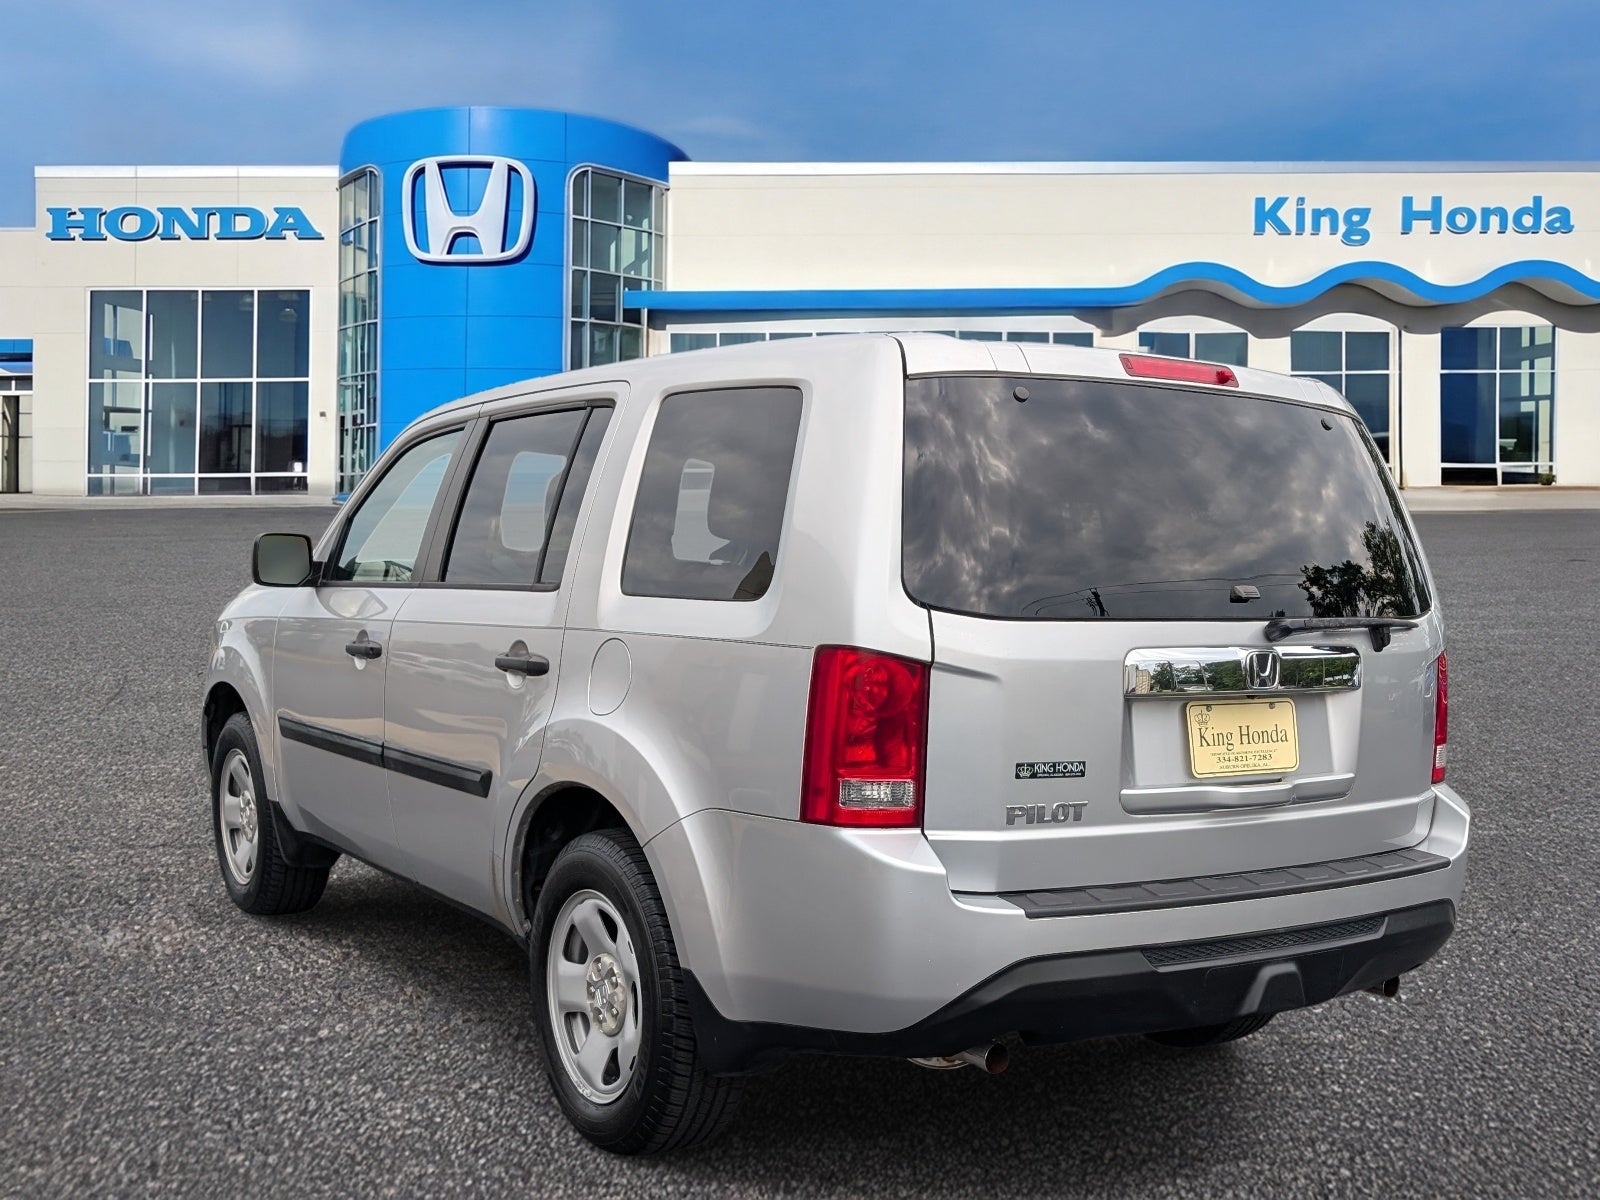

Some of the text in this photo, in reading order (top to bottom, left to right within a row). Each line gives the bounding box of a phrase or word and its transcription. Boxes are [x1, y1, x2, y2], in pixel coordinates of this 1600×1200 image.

[46, 206, 325, 241] HONDA
[1253, 195, 1575, 246] King Honda
[1198, 723, 1289, 752] King Honda
[1034, 762, 1085, 774] KING HONDA
[1216, 753, 1273, 764] 334-821-7283
[1006, 800, 1089, 825] PILOT
